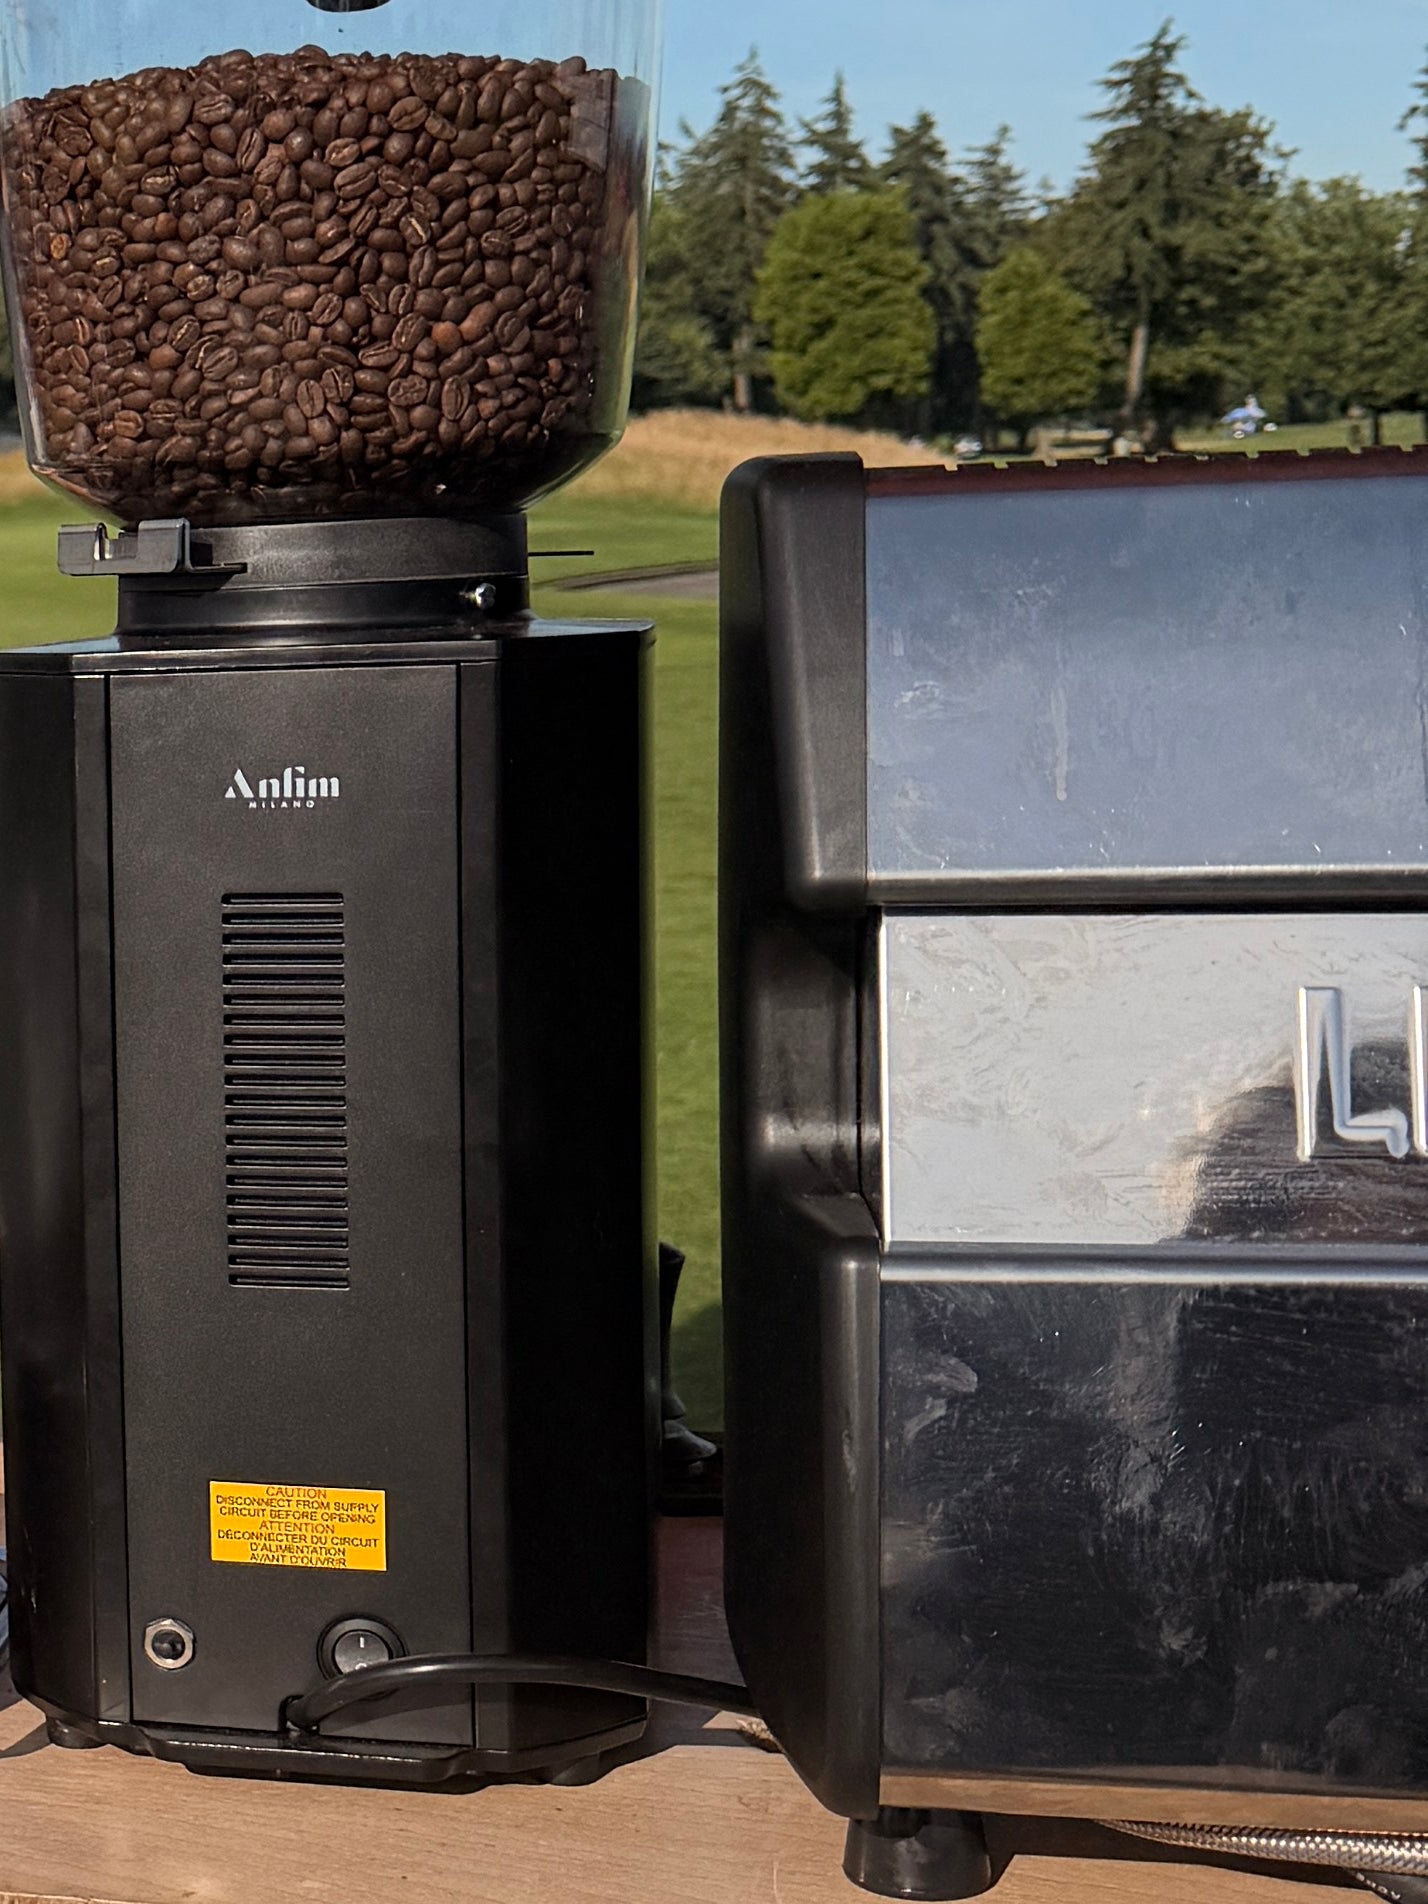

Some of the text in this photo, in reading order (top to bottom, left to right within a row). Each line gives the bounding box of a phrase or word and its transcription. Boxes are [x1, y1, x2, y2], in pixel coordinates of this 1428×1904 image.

[224, 766, 340, 798] Anfim
[249, 800, 315, 809] MILANO
[266, 1486, 327, 1498] CAUTION
[216, 1495, 379, 1513] DISCONNECT FROM SUPPLY
[220, 1506, 376, 1524] CIRCUIT BEFORE OPENING
[259, 1520, 335, 1534] ATTENTION
[311, 1535, 327, 1545] DU
[331, 1537, 379, 1548] CIRCUIT
[250, 1543, 345, 1556] D'ALIMENTATION
[250, 1553, 286, 1563] AVANT
